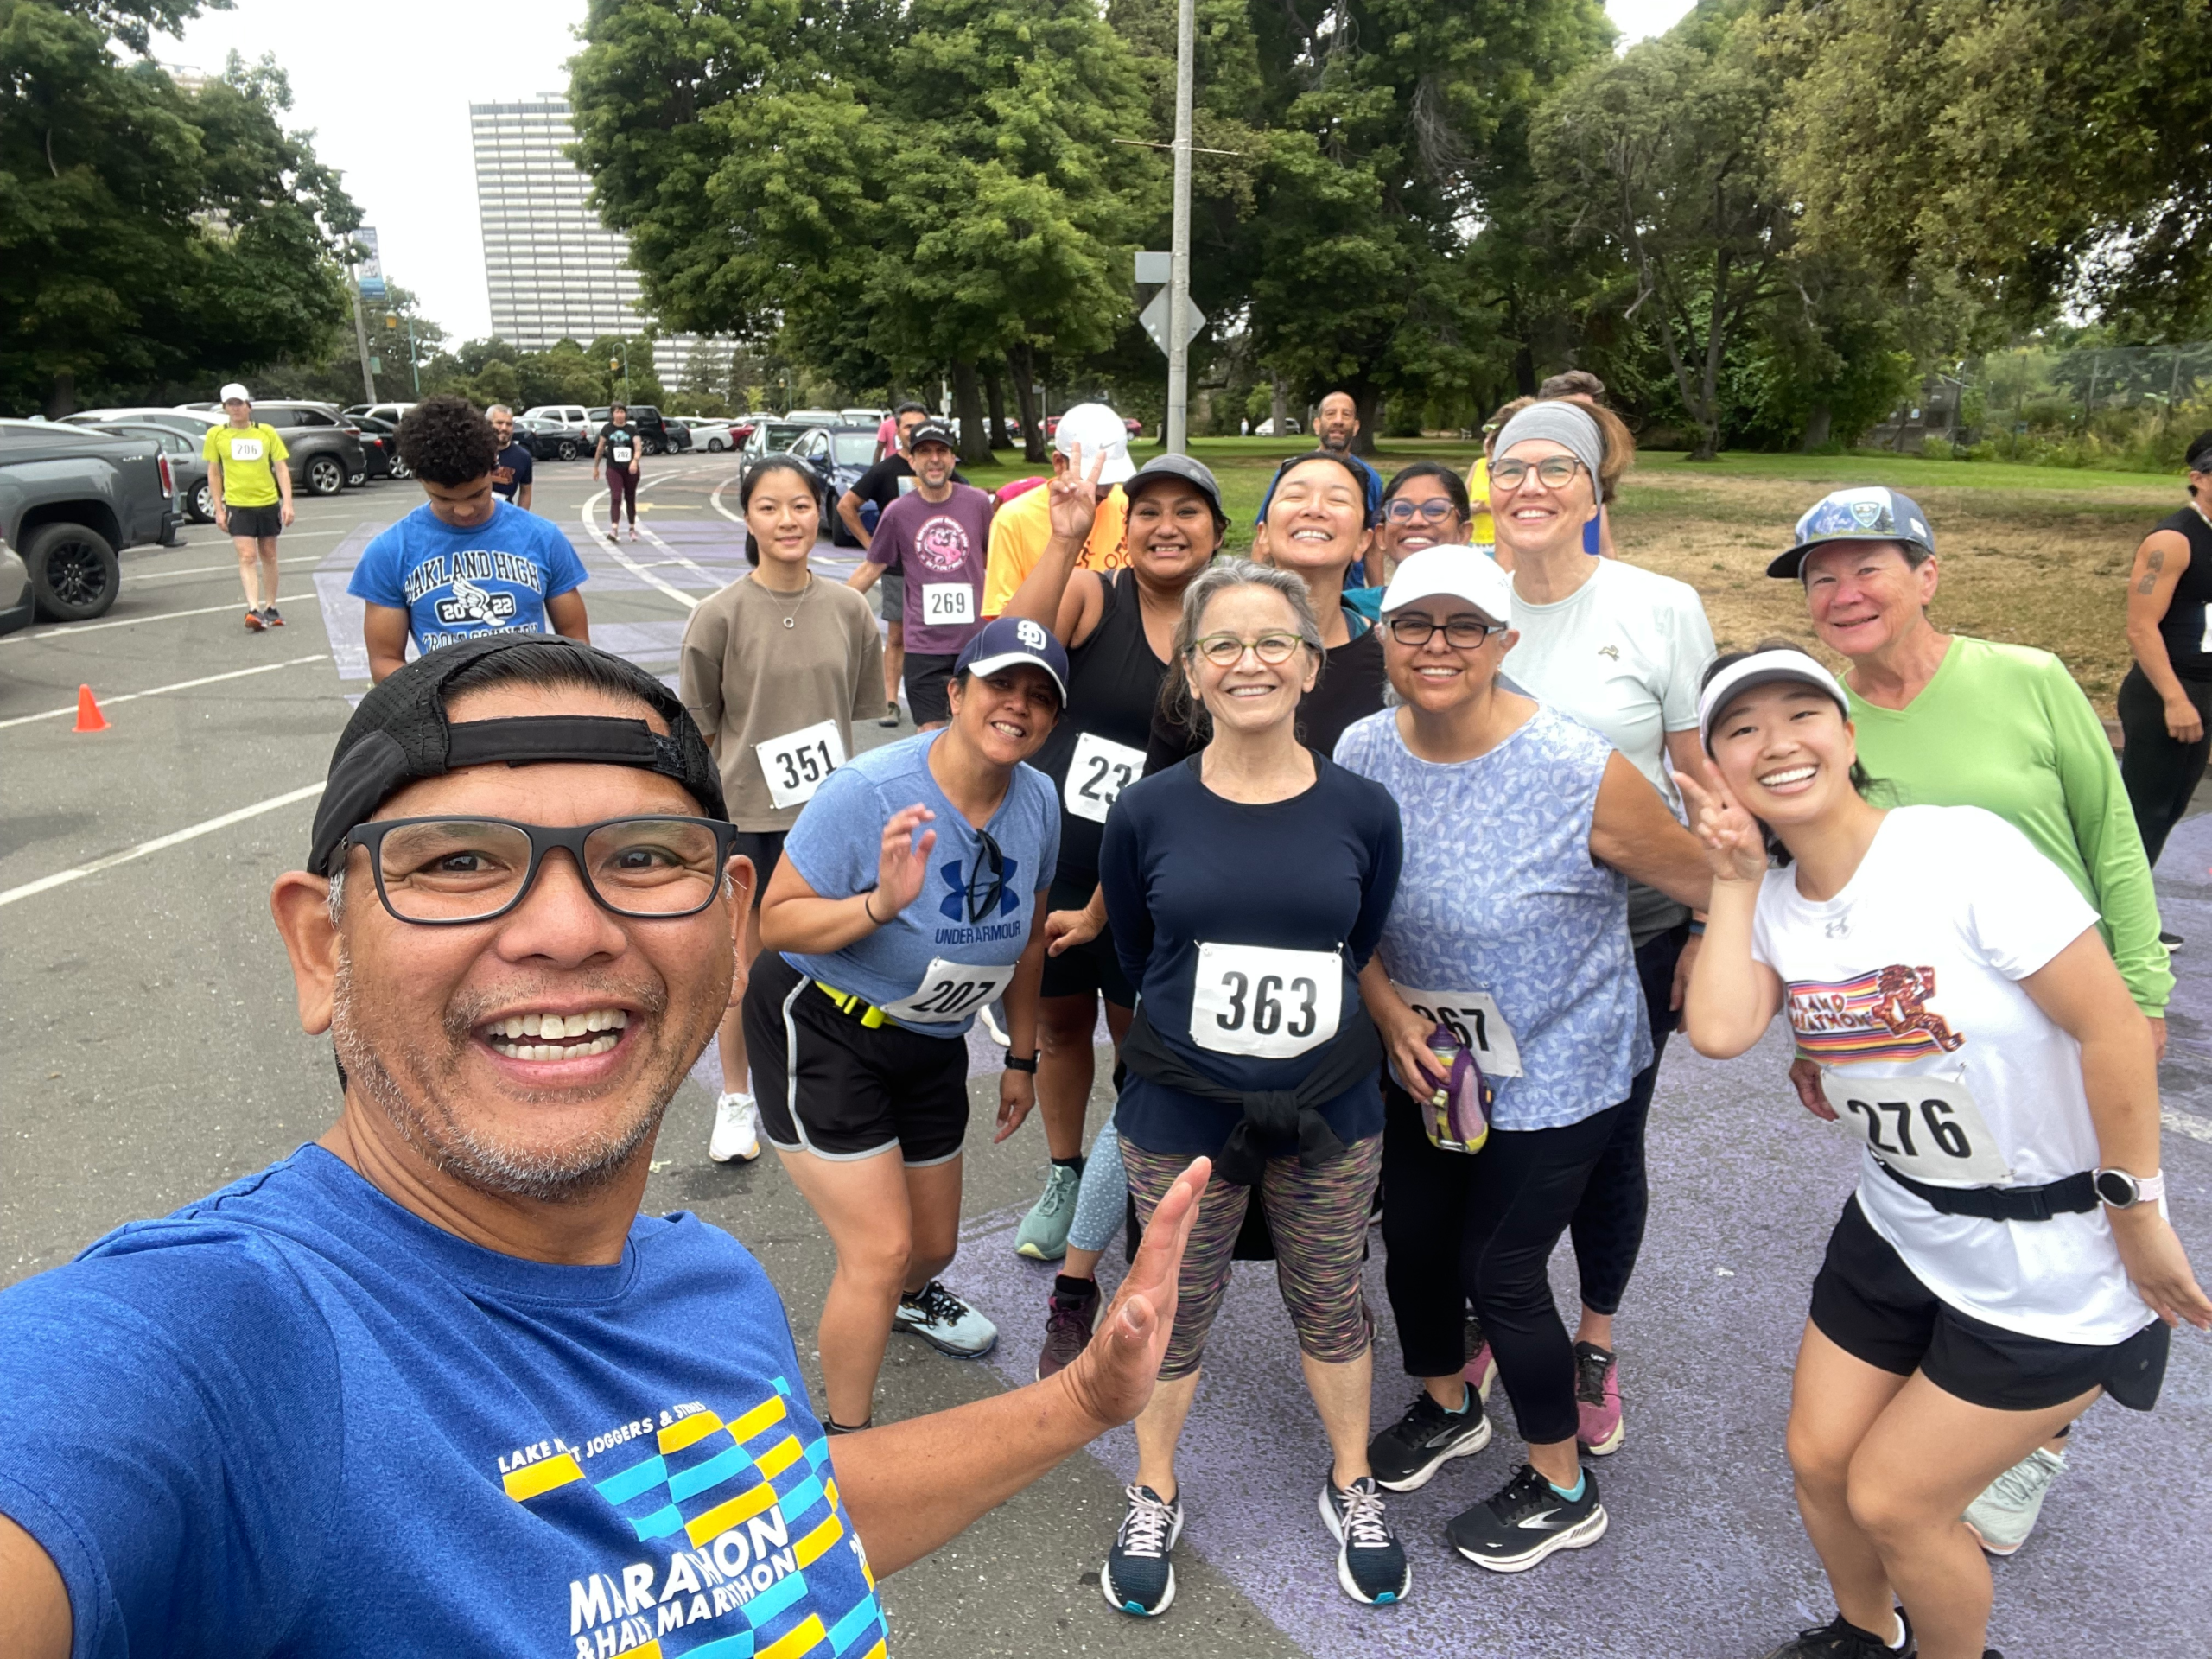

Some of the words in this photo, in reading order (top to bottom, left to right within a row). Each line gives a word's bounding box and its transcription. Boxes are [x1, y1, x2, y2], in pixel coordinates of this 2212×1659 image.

[237, 444, 257, 454] 206
[493, 550, 542, 594] HIGH
[931, 592, 966, 614] 269
[775, 739, 837, 790] 351
[935, 927, 974, 944] UNDER
[976, 920, 1021, 944] ARMOUR
[908, 980, 996, 1014] 207
[1216, 970, 1318, 1038] 363
[1847, 1098, 1973, 1159] 276
[497, 1441, 552, 1474] LAKE
[586, 1417, 654, 1459] JOGGERS
[659, 1409, 674, 1427] &
